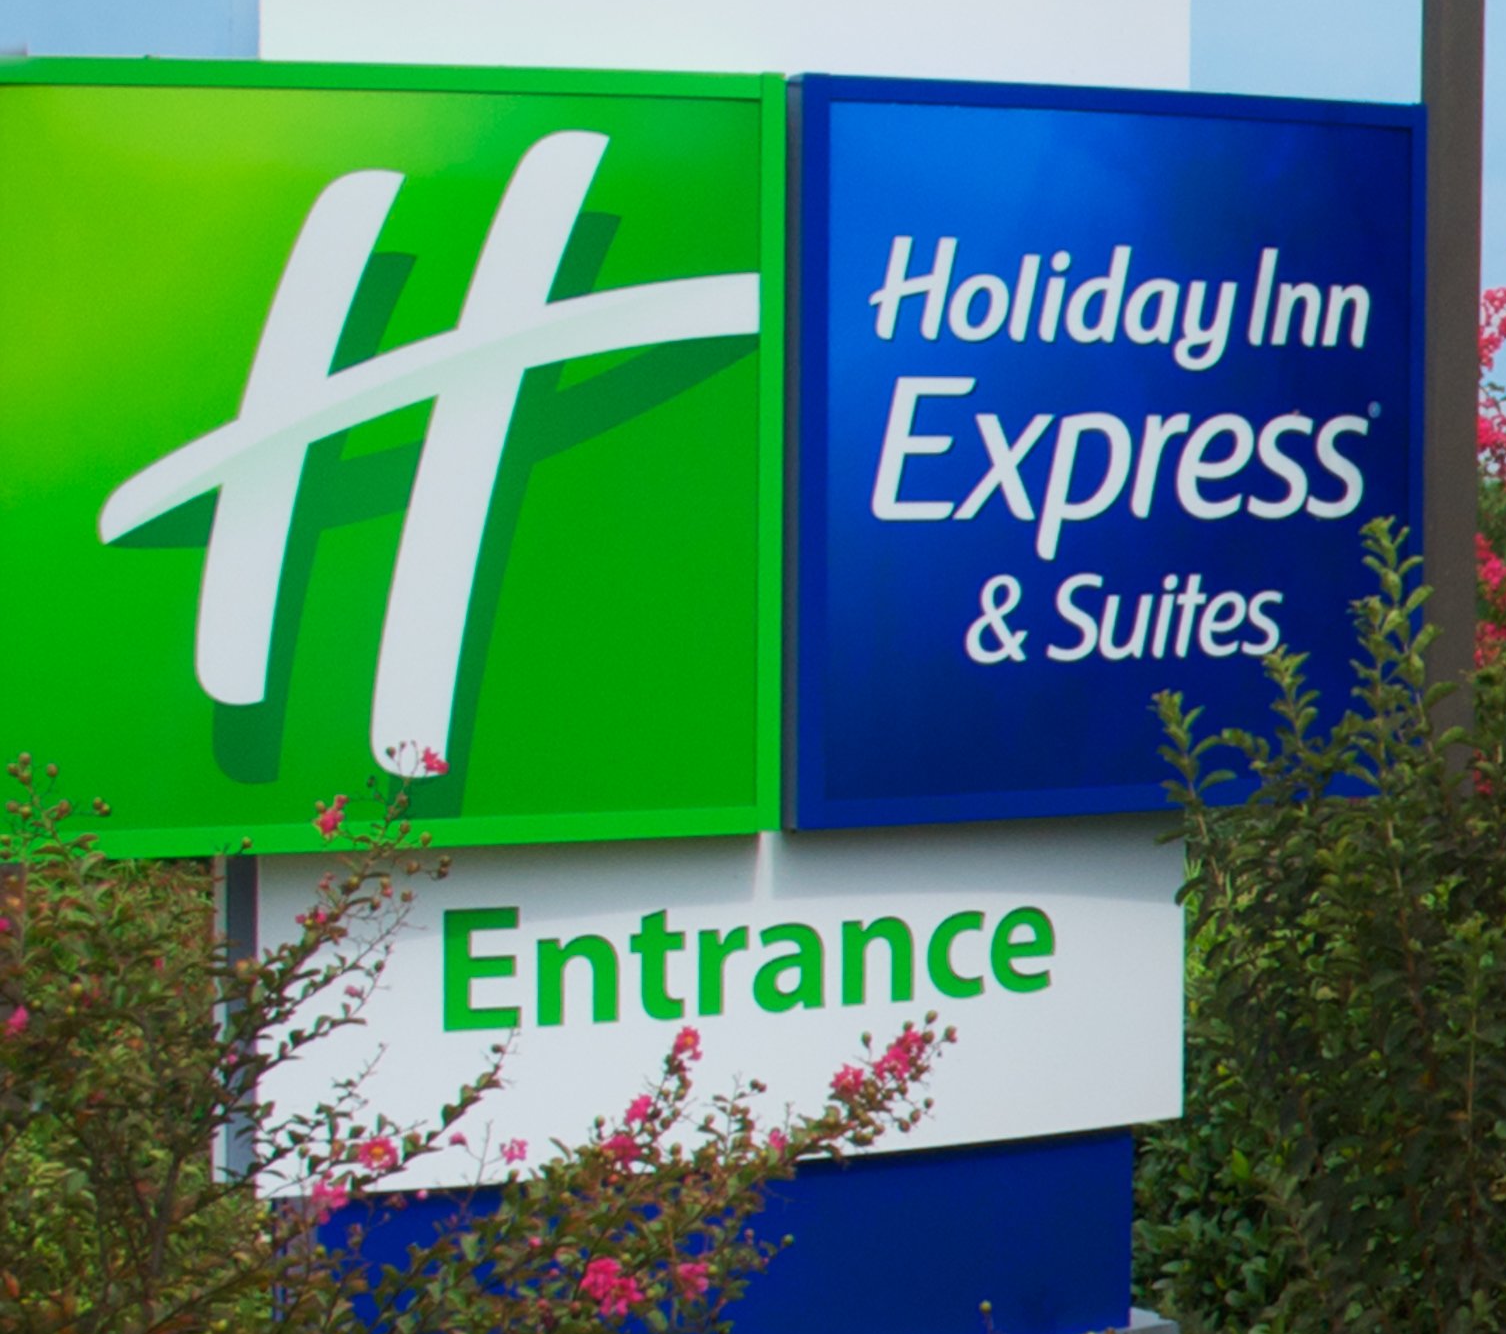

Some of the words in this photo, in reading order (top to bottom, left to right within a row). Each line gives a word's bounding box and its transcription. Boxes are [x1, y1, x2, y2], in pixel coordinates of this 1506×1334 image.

[869, 235, 1238, 371] Holiday
[1248, 247, 1371, 349] Inn
[870, 375, 1369, 561] Express
[964, 573, 1028, 664] &
[1046, 572, 1284, 662] Suites
[443, 905, 1056, 1033] Entrance
